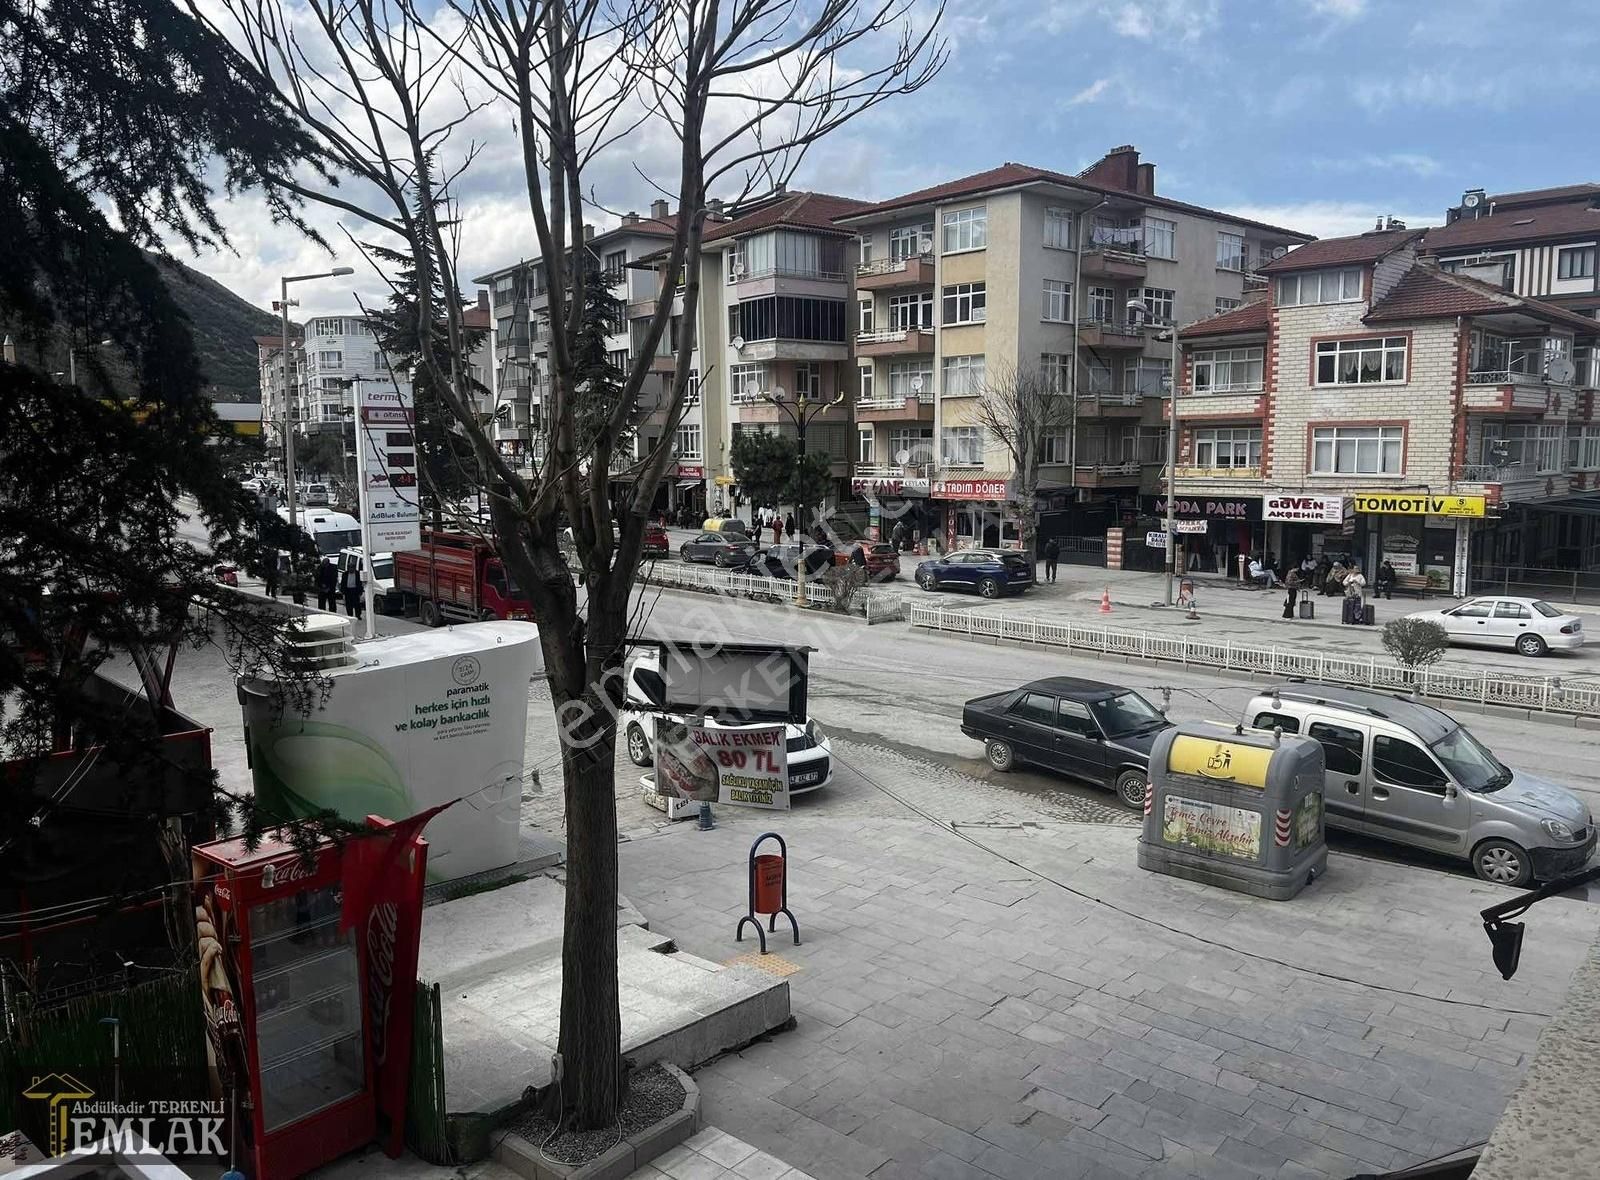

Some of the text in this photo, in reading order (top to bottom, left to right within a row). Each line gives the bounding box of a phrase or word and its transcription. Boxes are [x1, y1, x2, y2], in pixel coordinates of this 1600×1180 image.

[946, 482, 1005, 494] TADIM DÖNER
[1206, 502, 1247, 515] PARK
[1268, 510, 1324, 520] AKŞEHİR
[446, 682, 489, 698] paramatik
[415, 695, 490, 714] herkes için hızlı
[395, 709, 490, 732] ve kolay bankacılık
[693, 730, 780, 747] BALIK EKMEK
[717, 749, 780, 774] 80 TL
